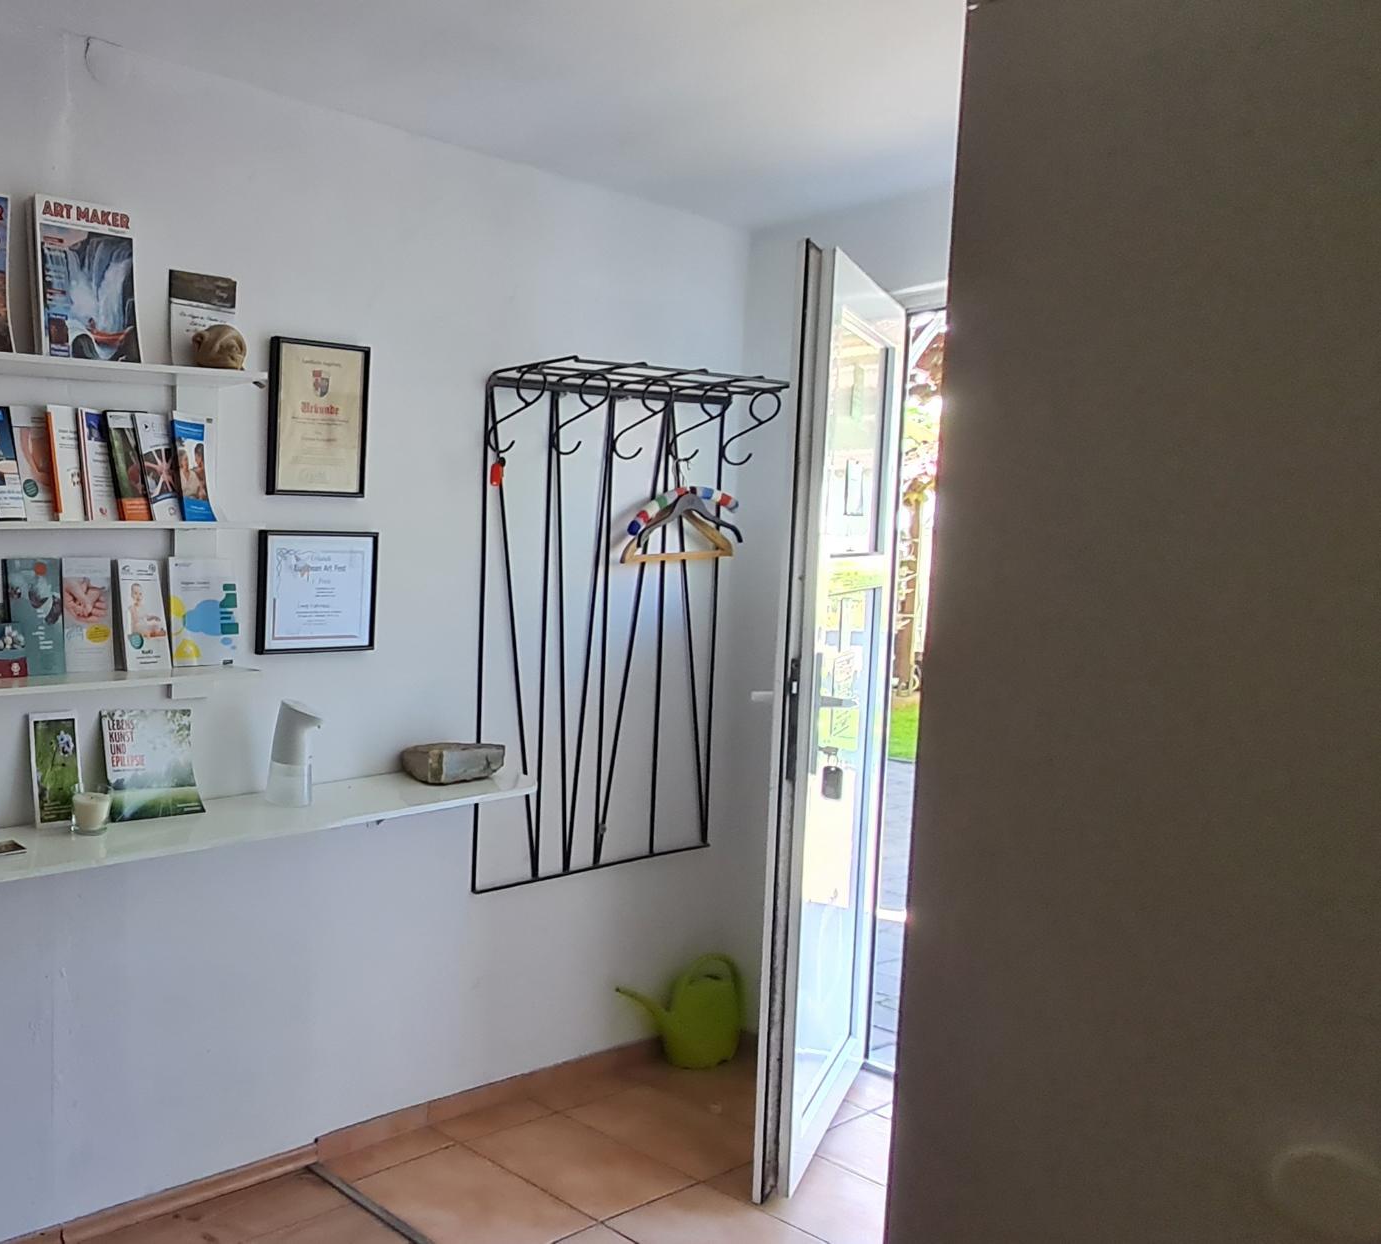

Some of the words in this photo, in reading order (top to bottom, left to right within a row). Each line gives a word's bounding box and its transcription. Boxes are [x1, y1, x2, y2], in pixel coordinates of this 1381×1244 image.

[42, 200, 73, 219] ART
[76, 206, 130, 229] MAKER
[109, 731, 134, 743] KUNST
[110, 743, 126, 755] UND
